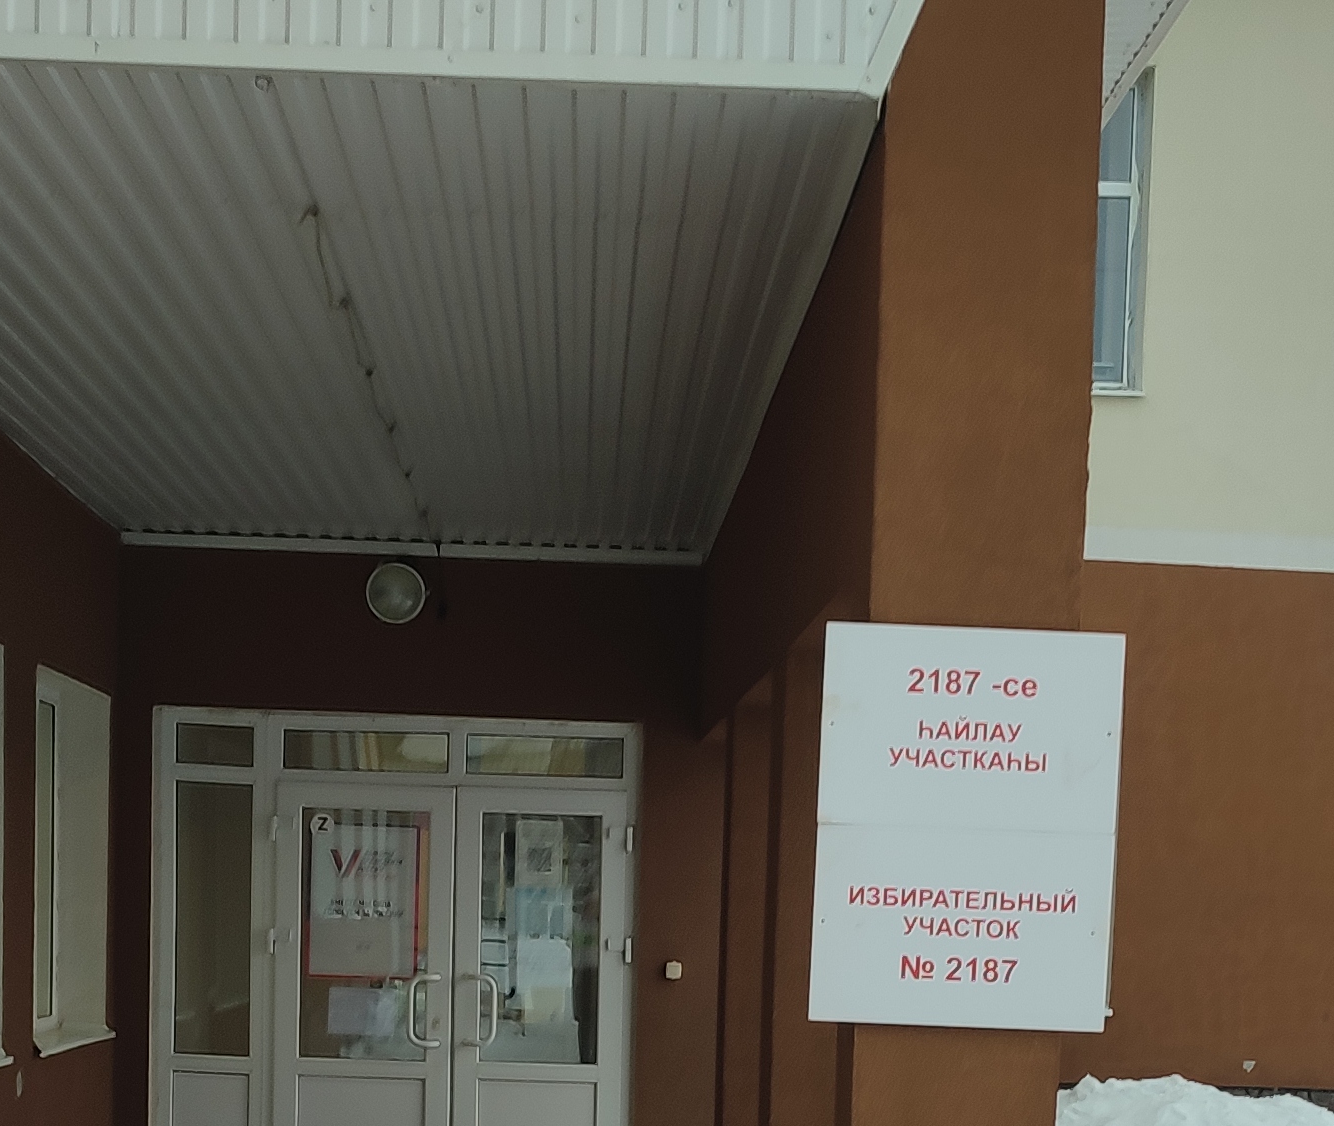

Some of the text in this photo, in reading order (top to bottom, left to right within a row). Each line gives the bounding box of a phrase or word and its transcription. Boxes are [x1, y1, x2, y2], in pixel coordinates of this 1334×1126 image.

[907, 667, 982, 696] 2187
[848, 885, 1077, 914] ИЗБИРАТЕЛЬНЫЙ
[903, 915, 1021, 940] УЧАСТОК
[900, 954, 1018, 983] № 2187
